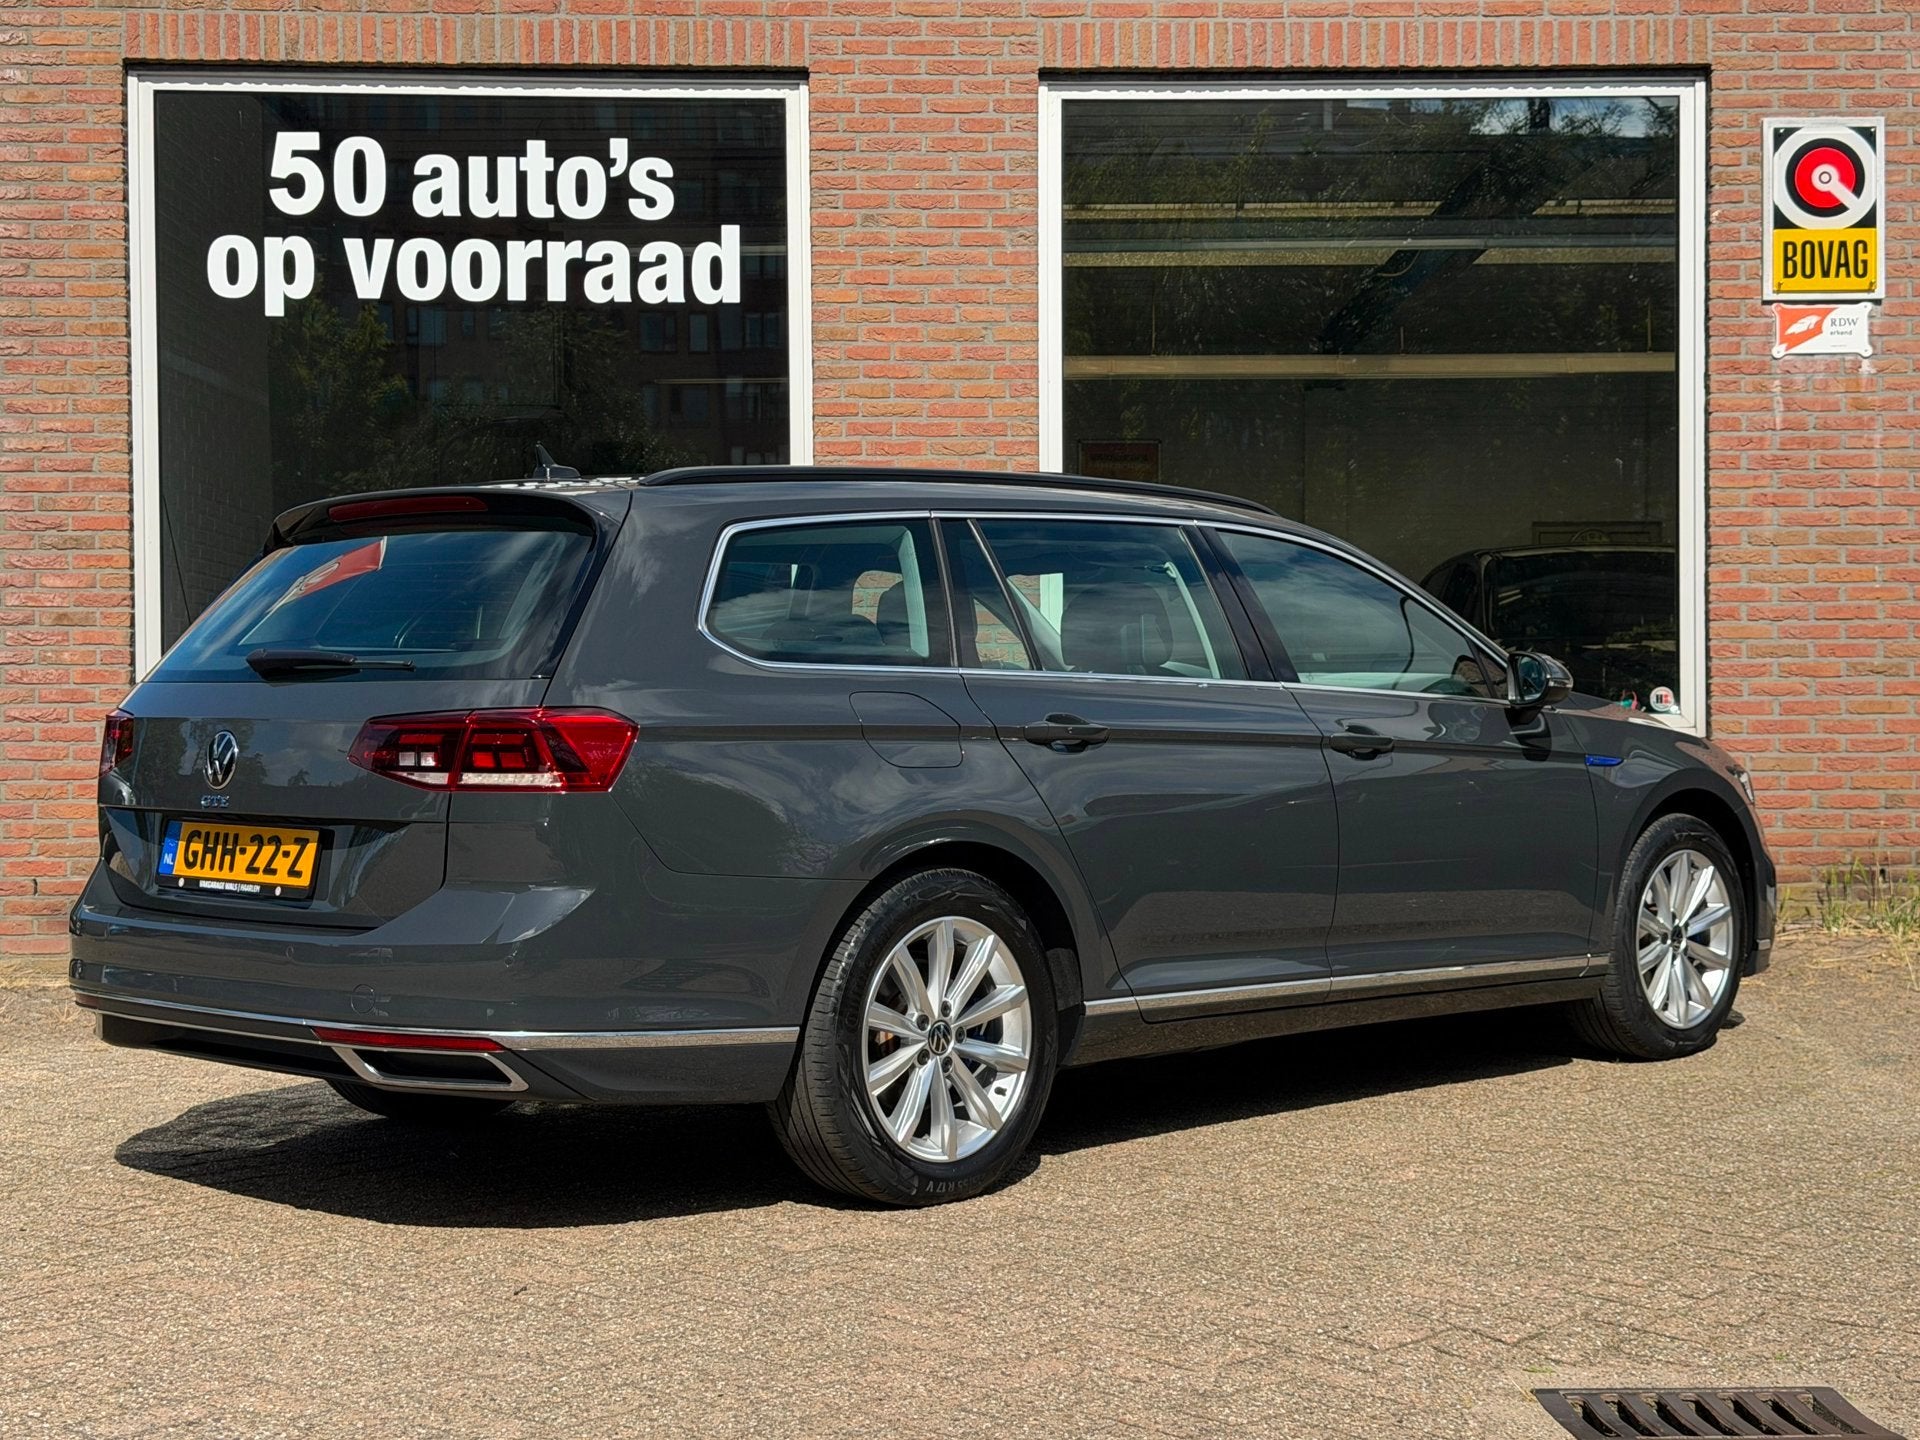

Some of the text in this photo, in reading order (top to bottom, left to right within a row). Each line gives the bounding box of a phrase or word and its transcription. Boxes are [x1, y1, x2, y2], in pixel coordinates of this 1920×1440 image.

[269, 131, 675, 221] 50 auto's
[206, 224, 741, 317] op voorraad
[1782, 239, 1868, 279] BOVAG
[1830, 317, 1860, 327] RDW
[163, 852, 174, 865] NL
[183, 829, 310, 879] GHH-22-Z
